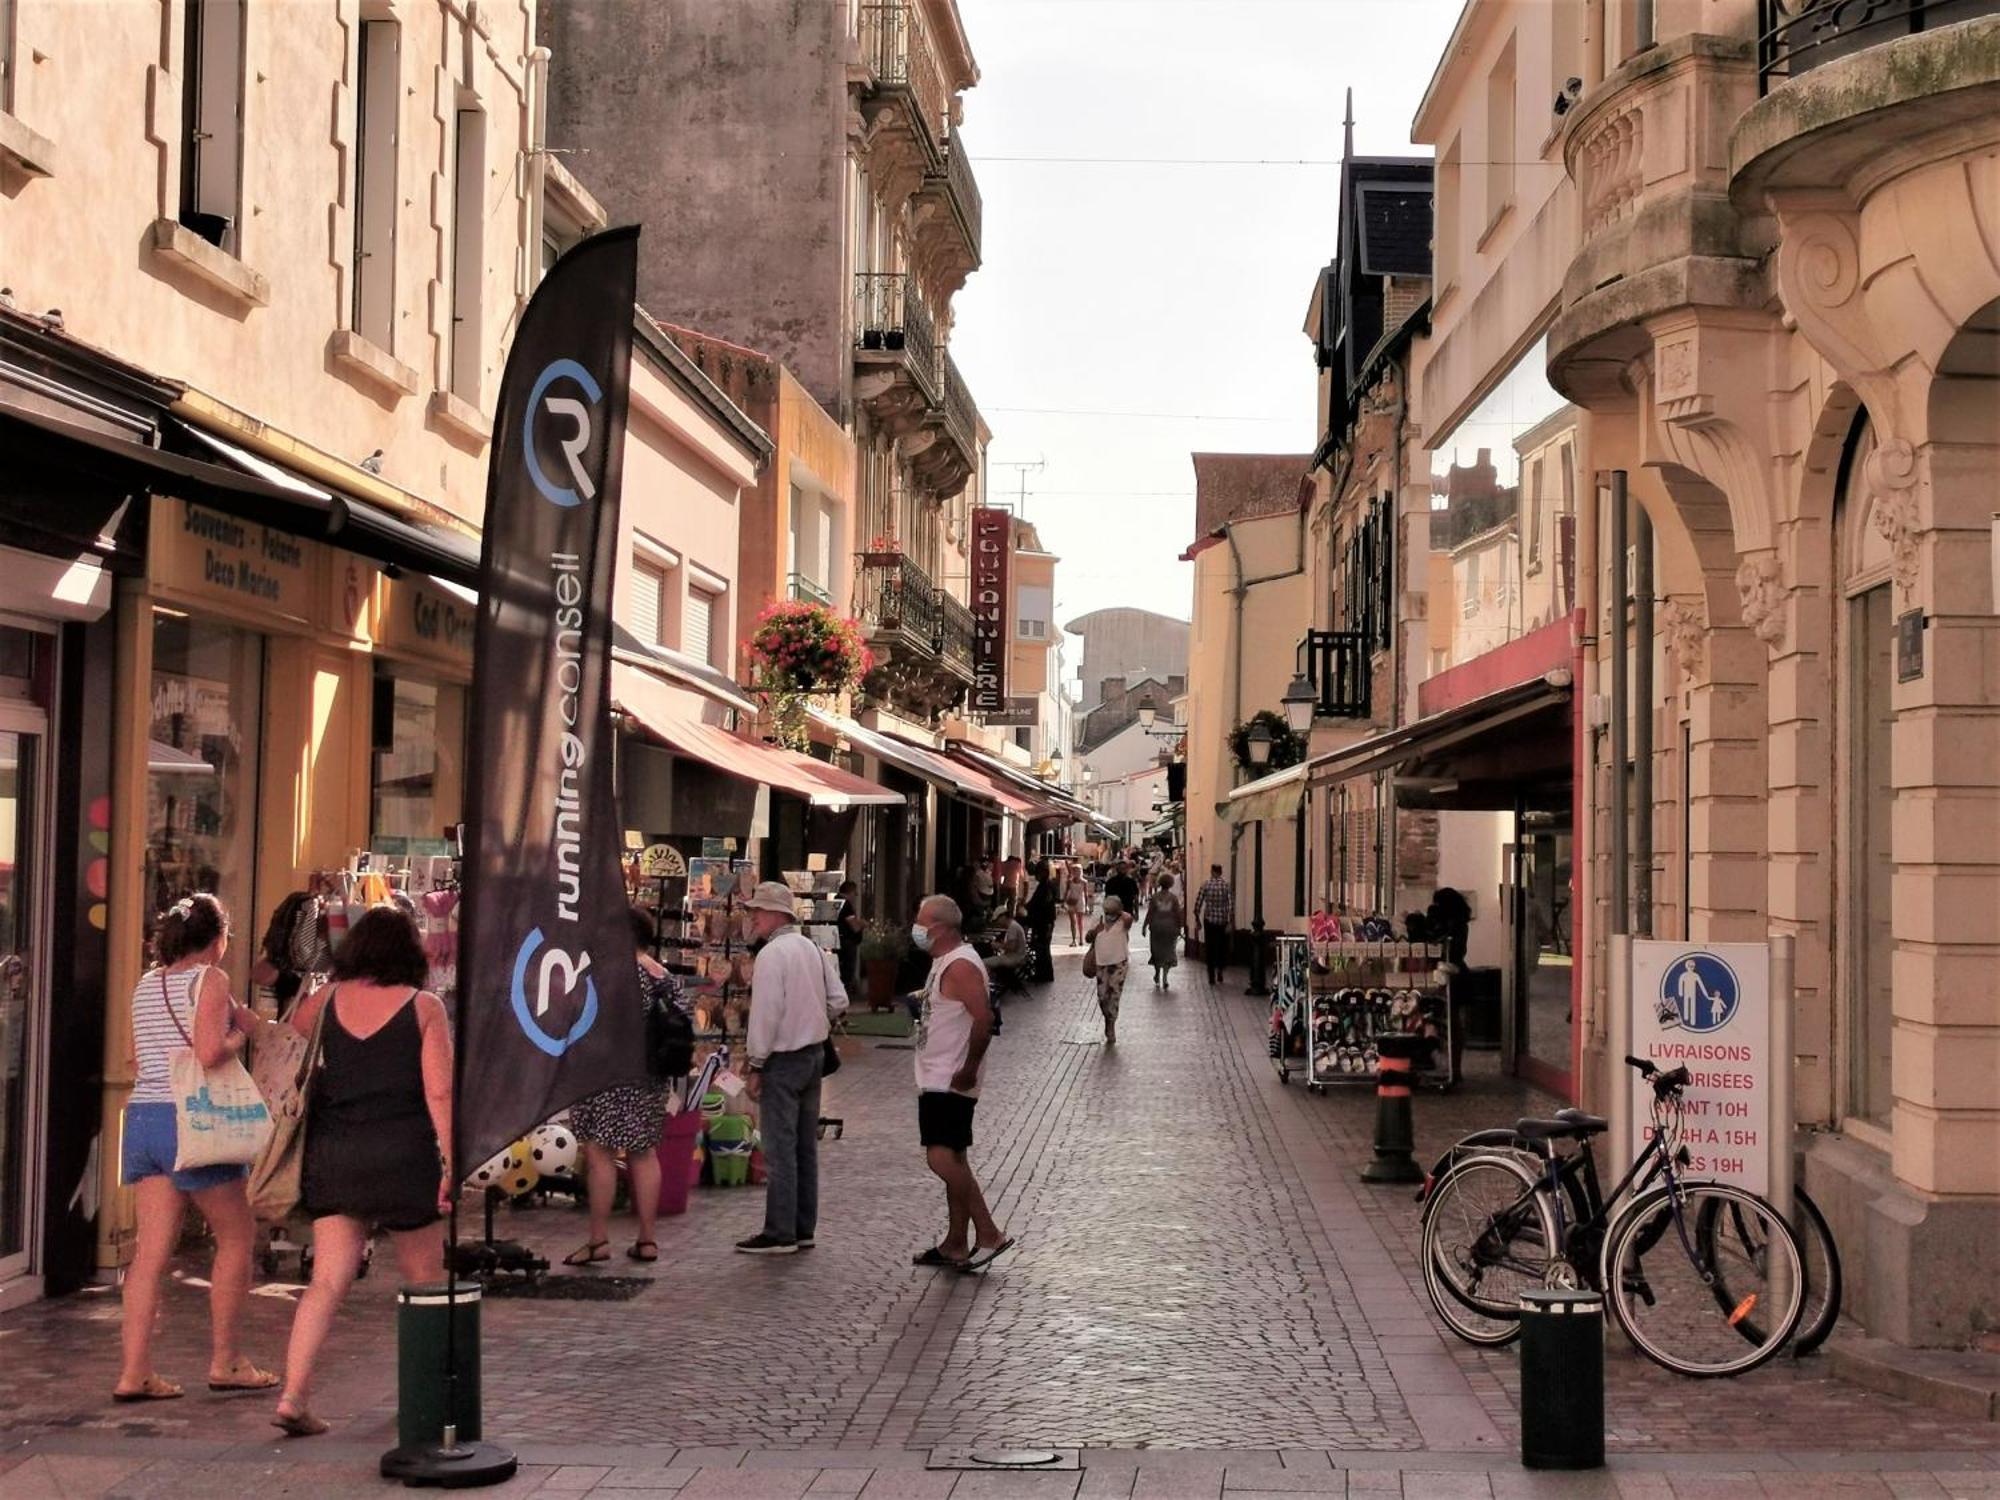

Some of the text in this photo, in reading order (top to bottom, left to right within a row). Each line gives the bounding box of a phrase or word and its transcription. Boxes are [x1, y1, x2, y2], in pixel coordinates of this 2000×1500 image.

[1649, 1042, 1752, 1062] LIVRAISONS
[1715, 1101, 1749, 1118] 10H
[1706, 1129, 1719, 1144] A
[1725, 1130, 1757, 1146] 15H
[1711, 1158, 1745, 1174] 19H
